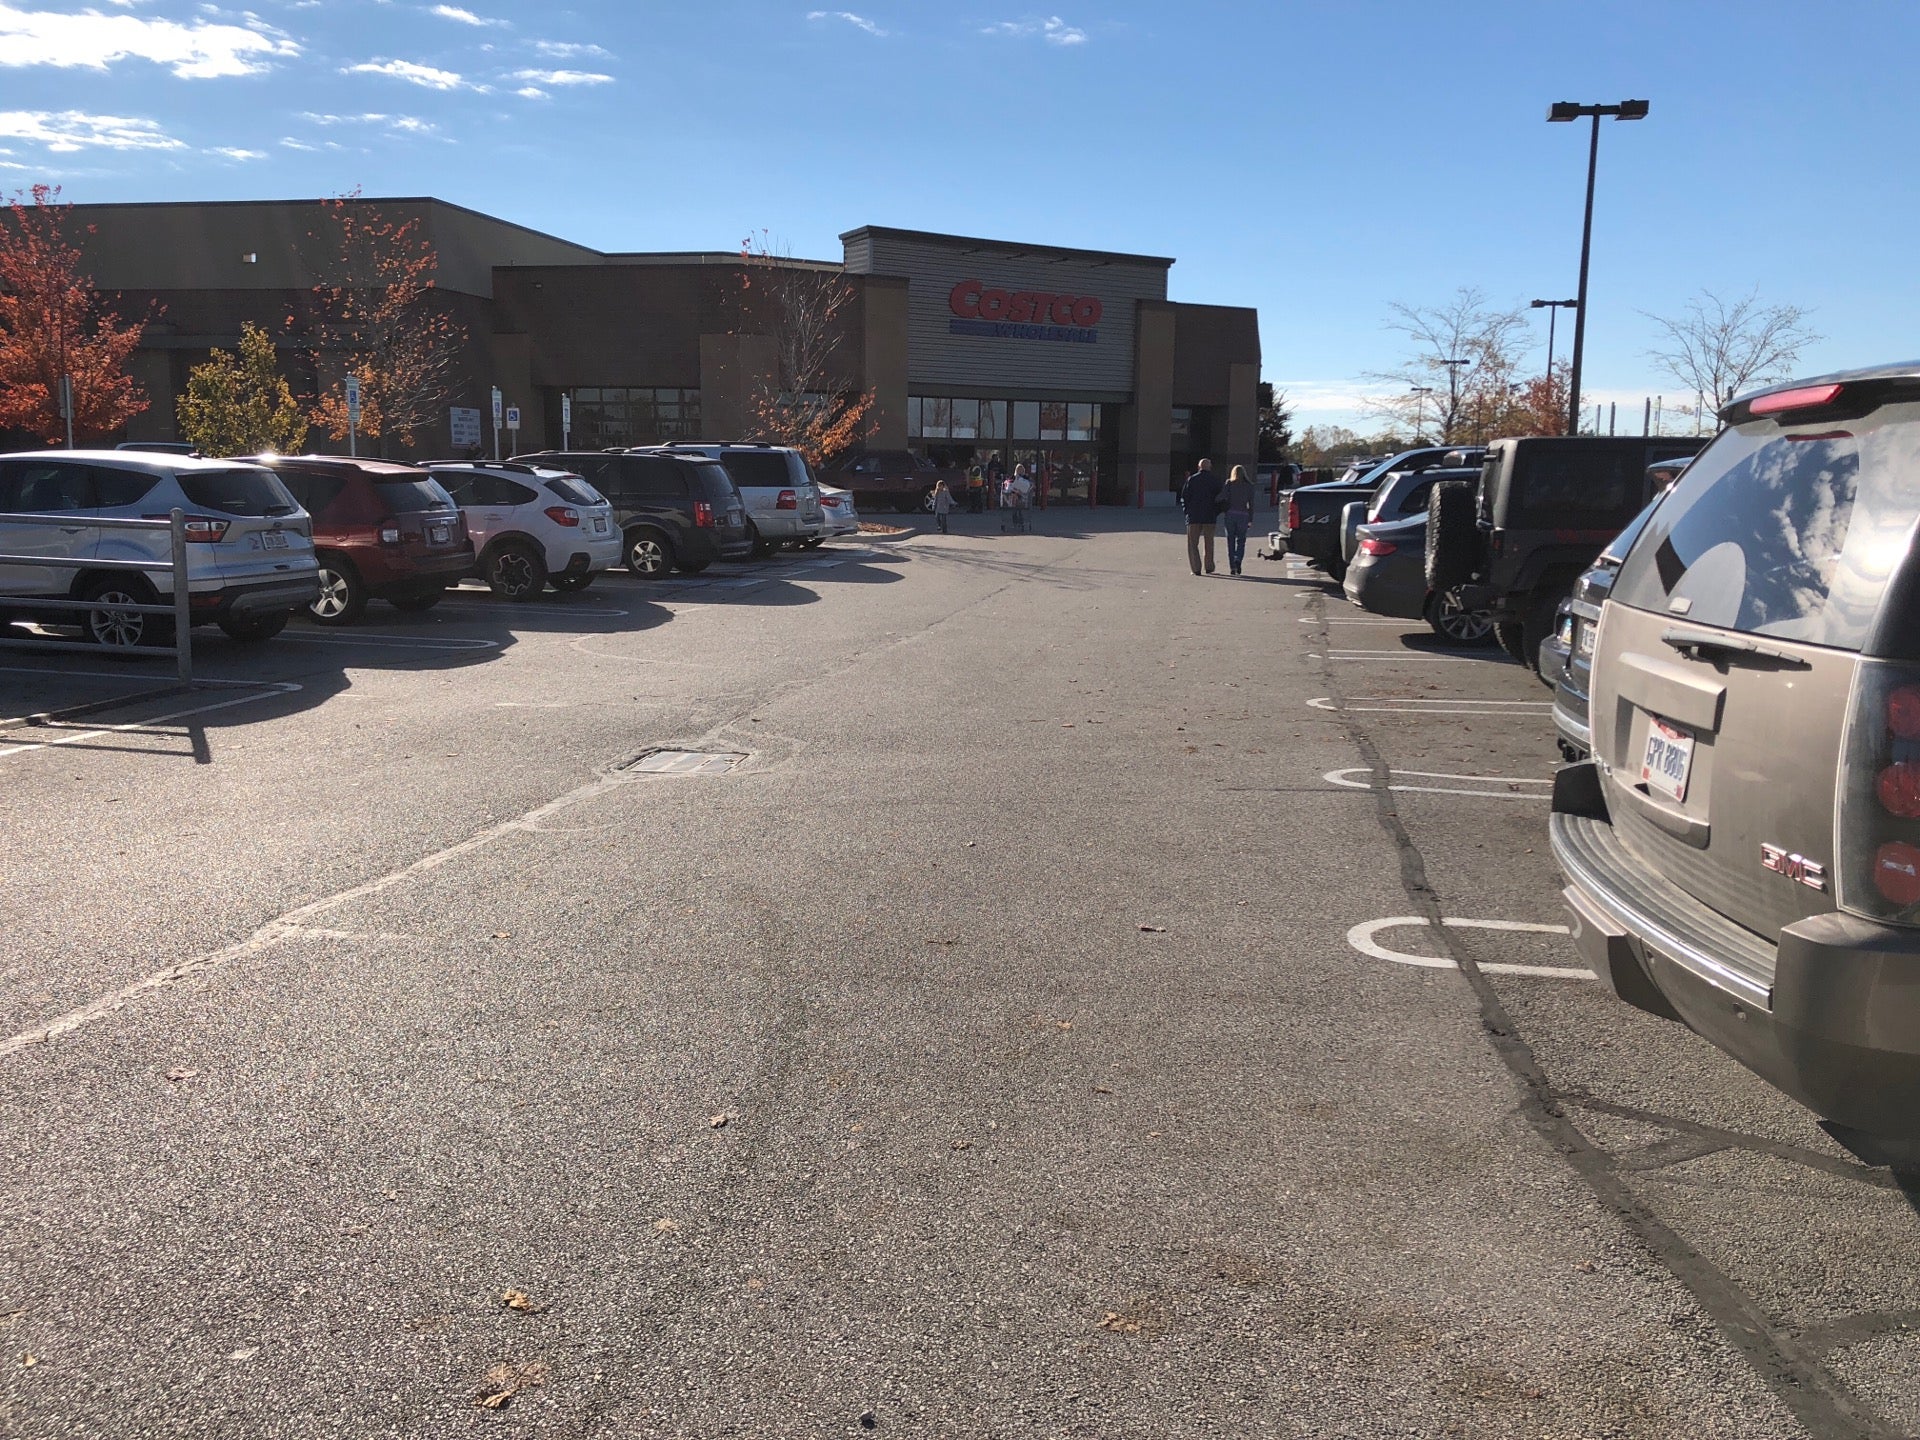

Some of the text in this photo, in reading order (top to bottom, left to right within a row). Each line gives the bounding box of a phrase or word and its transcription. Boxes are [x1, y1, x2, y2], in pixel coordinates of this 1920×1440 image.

[949, 279, 1103, 327] COSTCO
[994, 322, 1098, 343] WHOLESALE
[1760, 842, 1824, 890] GMC
